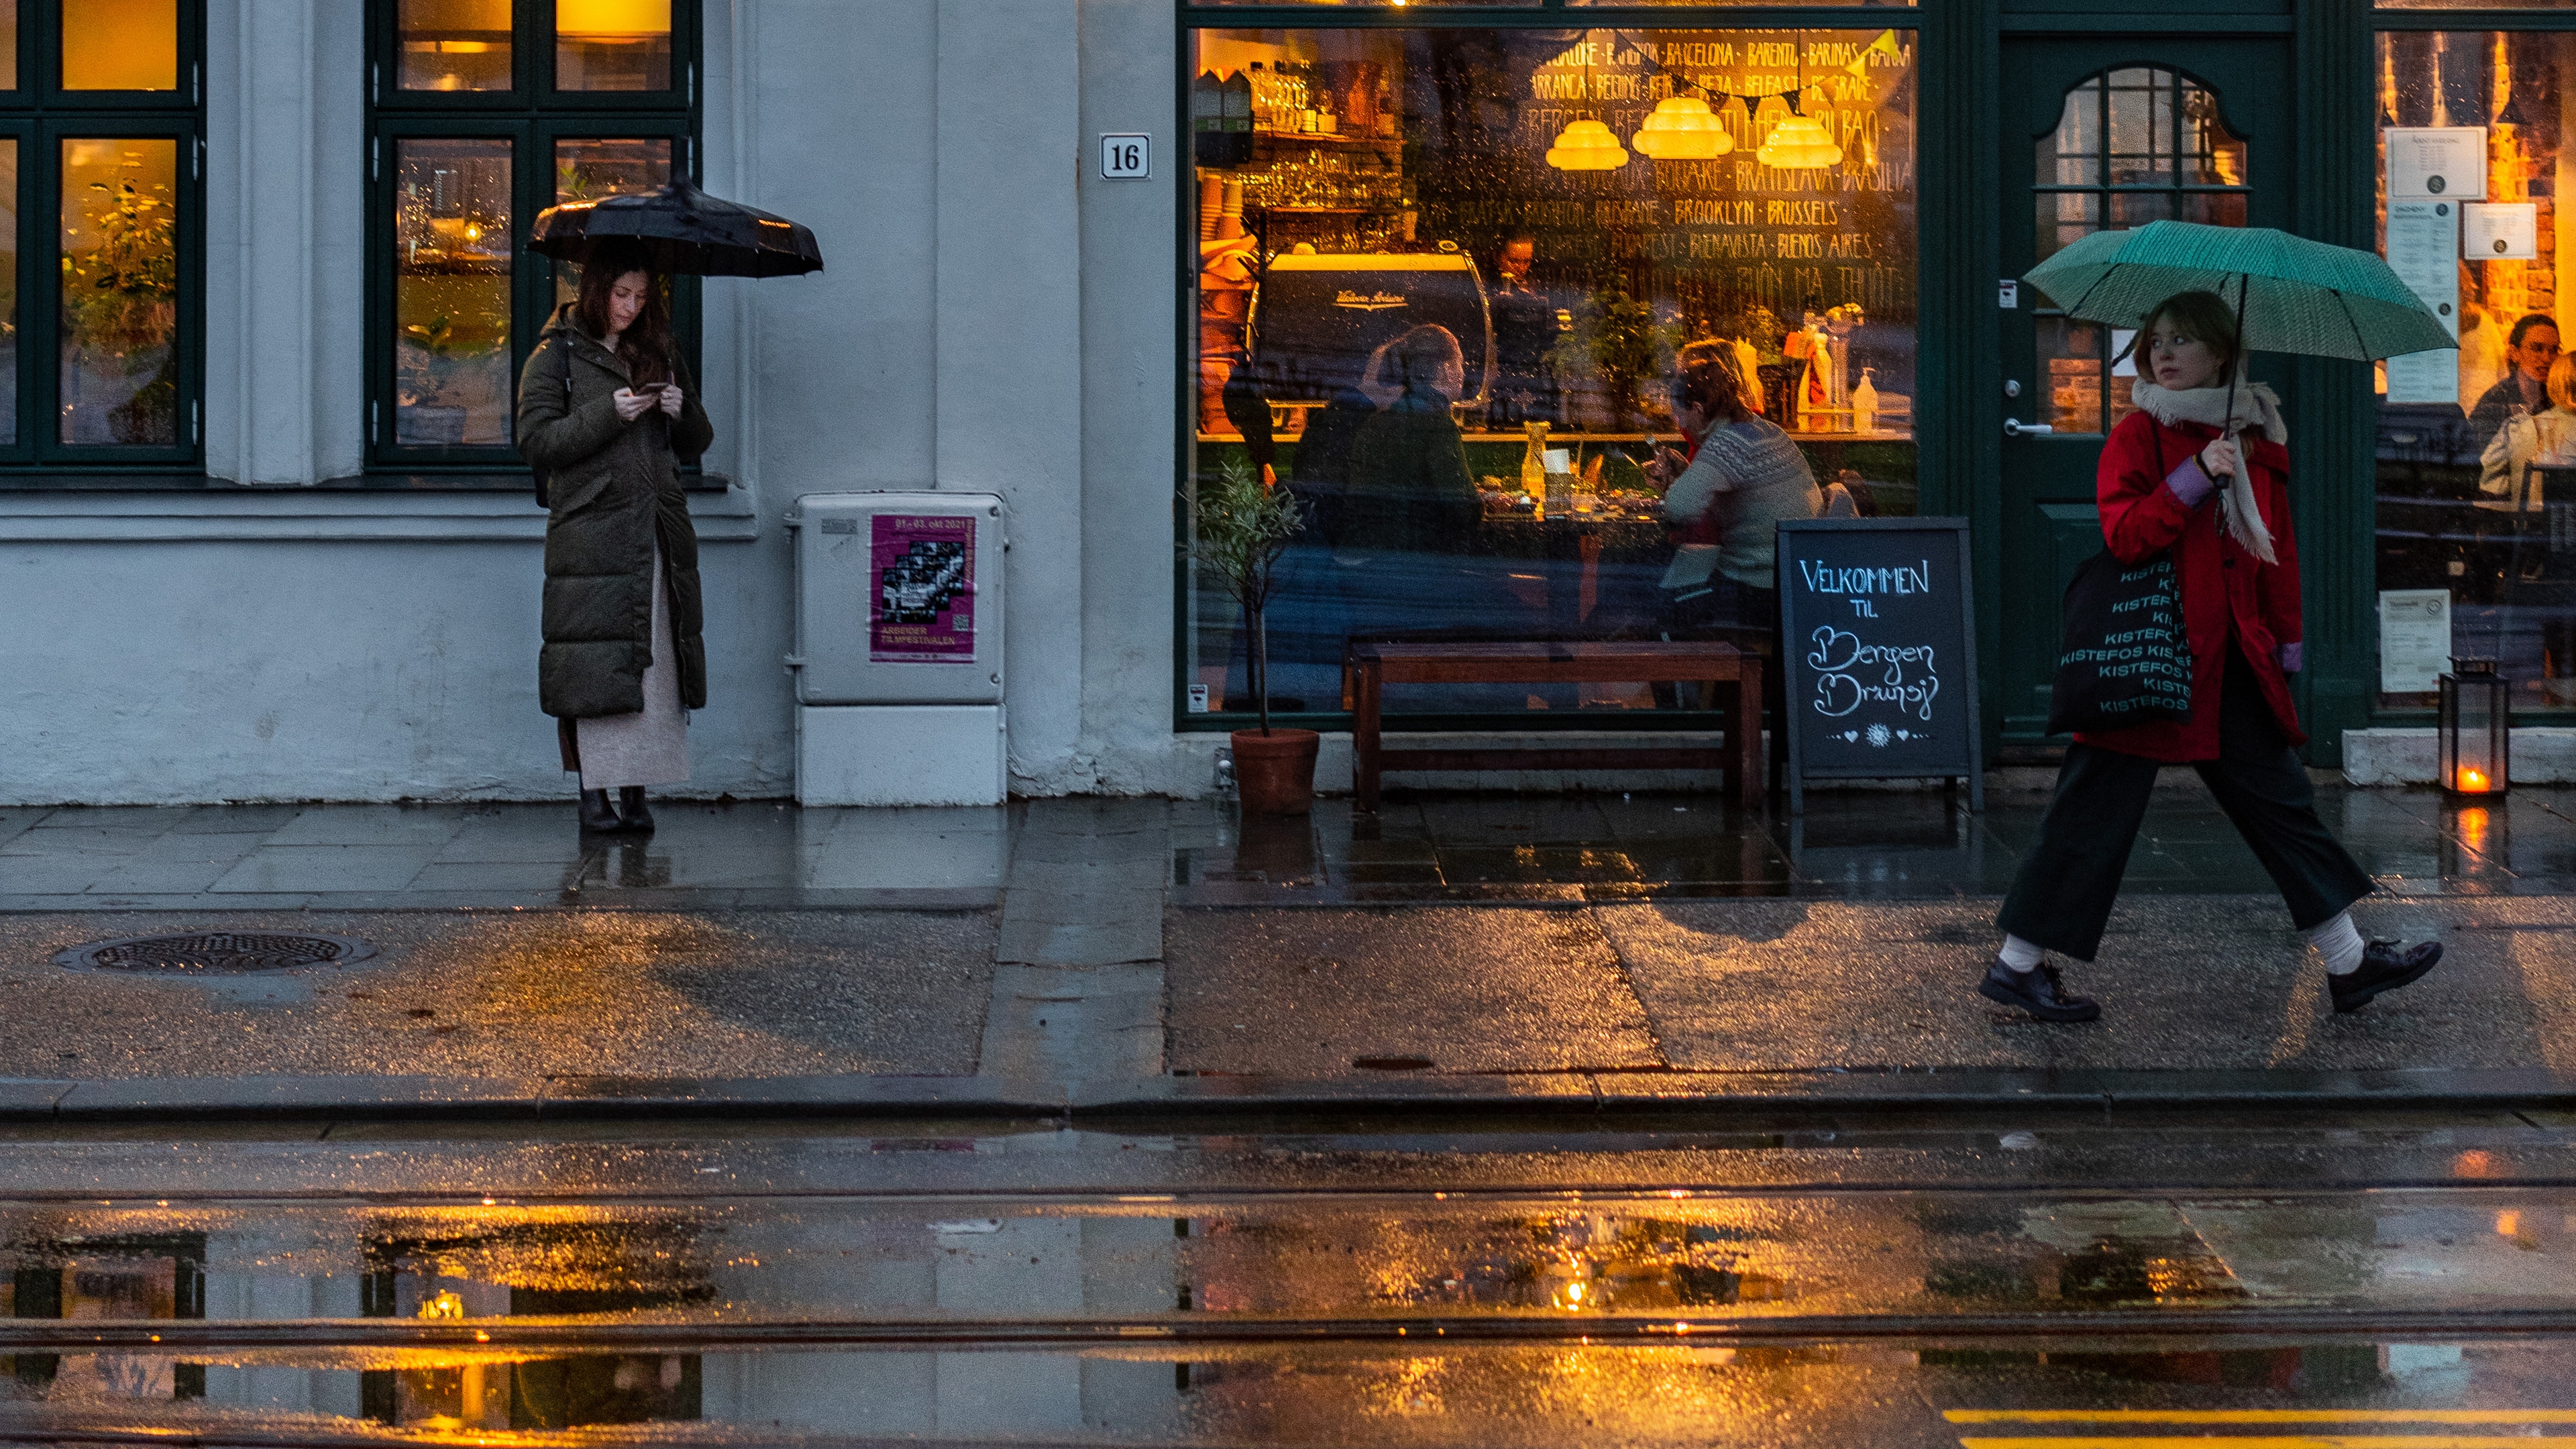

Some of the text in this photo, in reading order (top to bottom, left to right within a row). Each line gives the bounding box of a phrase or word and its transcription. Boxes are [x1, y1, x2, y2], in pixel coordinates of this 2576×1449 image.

[1666, 42, 1734, 66] BARCELONA
[1112, 144, 1138, 170] 16
[1674, 200, 1755, 225] BROOKLYN
[1767, 200, 1839, 225] BRUSSELS
[1777, 233, 1823, 259] BUENOS
[1827, 233, 1873, 259] AIRES
[945, 519, 965, 529] 2021
[1799, 559, 1929, 594] VELKOMMEN
[1849, 599, 1878, 619] TIL
[1807, 625, 1937, 686] Bergen
[2061, 645, 2143, 667] KISTEFOS
[2099, 661, 2182, 678] KISTEFOS
[2100, 695, 2188, 712] KISTEFOS
